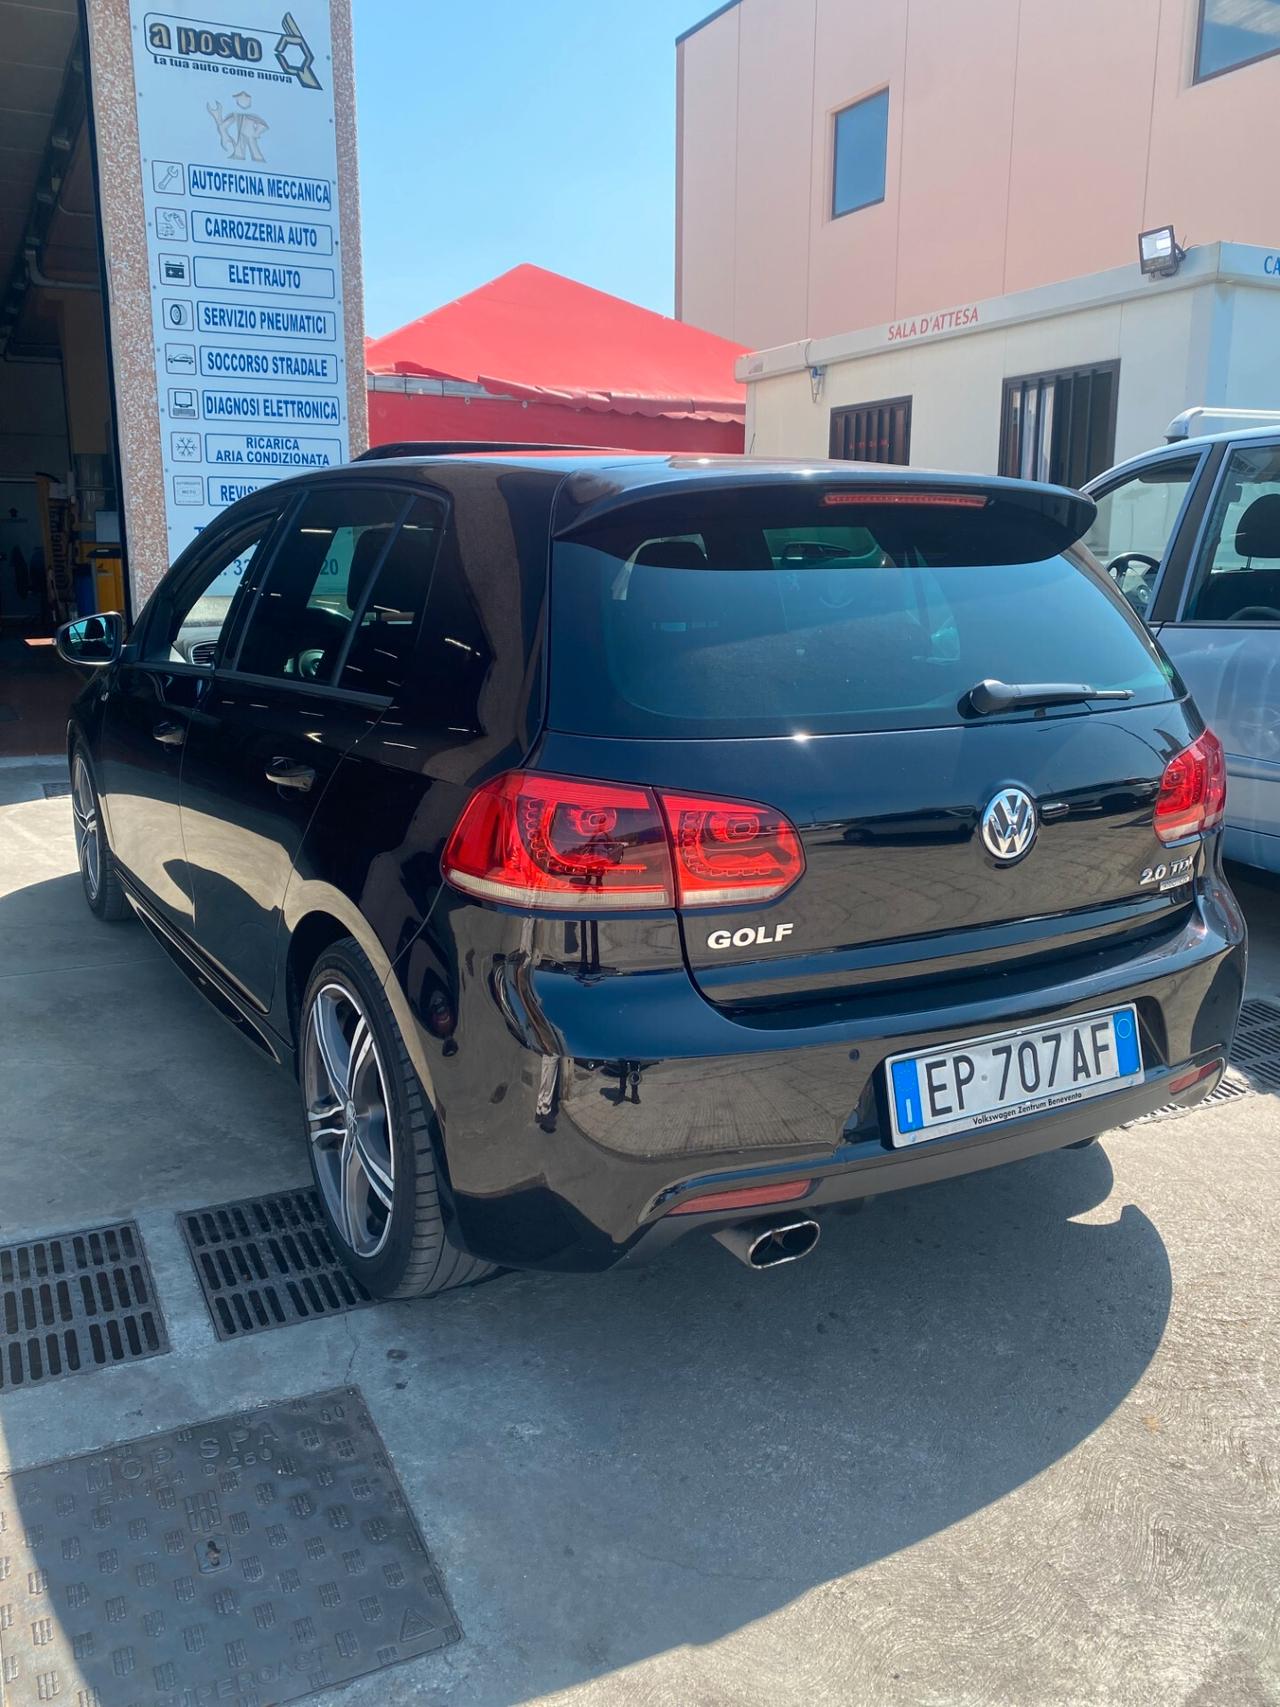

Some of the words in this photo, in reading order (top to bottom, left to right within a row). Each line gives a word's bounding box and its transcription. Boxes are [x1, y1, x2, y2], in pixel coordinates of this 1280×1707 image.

[149, 22, 171, 49] a
[176, 26, 262, 62] posto
[153, 55, 167, 65] La
[170, 58, 189, 69] tua
[192, 61, 219, 73] auto
[222, 66, 255, 79] come
[257, 72, 293, 84] nuova
[192, 170, 264, 196] AUTOFFICINA
[267, 178, 330, 204] MECCANICA
[205, 217, 285, 243] CARROZZERIA
[288, 226, 317, 247] AUTO
[228, 264, 301, 289] ELETTRAUTO
[204, 307, 257, 328] SERVIZIO
[260, 311, 327, 334] PNEUMATICI
[888, 322, 917, 341] SALA
[920, 306, 979, 334] D'ATTESA
[207, 351, 269, 373] SOCCORSO
[272, 356, 328, 377] STRADALE
[206, 396, 260, 416] DIAGNOSI
[263, 399, 338, 419] ELETTRONICA
[246, 437, 300, 450] RICARICA
[216, 450, 244, 462] ARIA
[247, 451, 330, 465] CONDIZIONATA
[220, 485, 258, 501] REVIS
[1139, 864, 1167, 885] 2.0
[707, 923, 794, 949] GOLF
[925, 1055, 975, 1117] EP
[992, 1022, 1110, 1101] 707AF
[972, 1110, 1016, 1125] Volkswagen
[1018, 1102, 1047, 1114] Zentrum
[1048, 1092, 1083, 1106] Benevento
[200, 1422, 279, 1459] SPA
